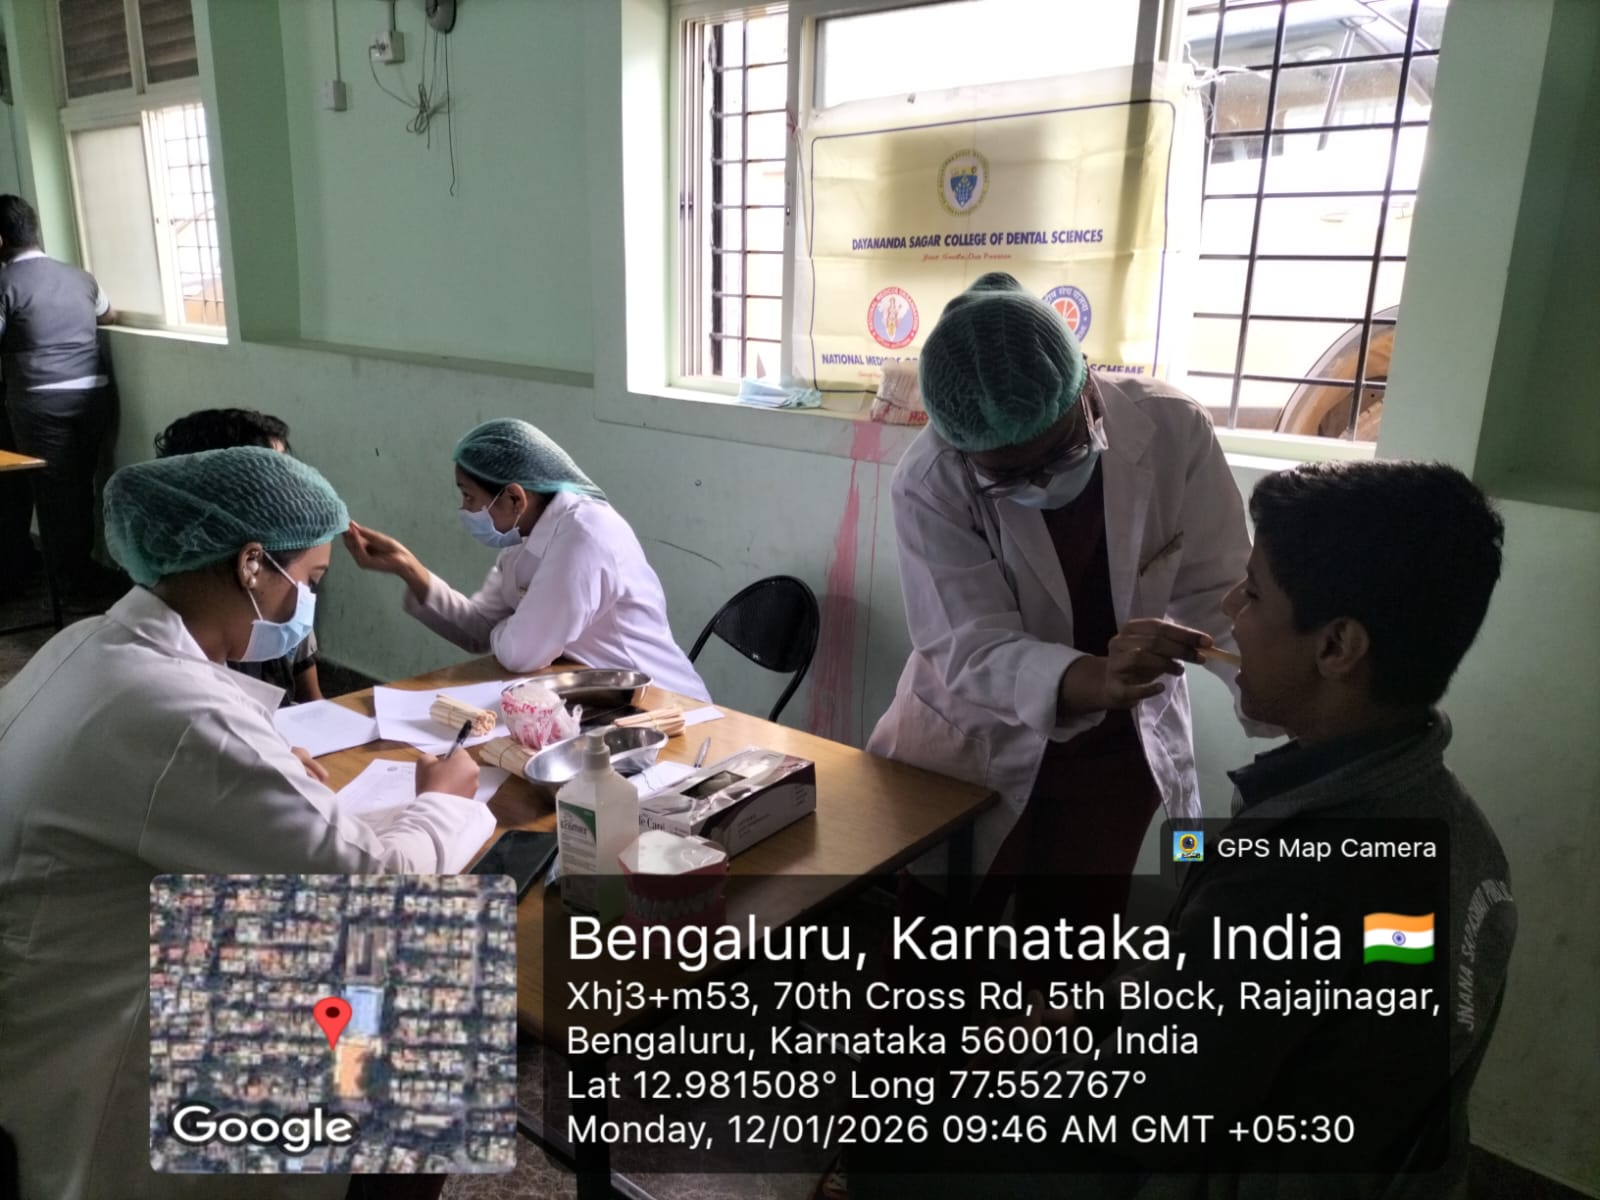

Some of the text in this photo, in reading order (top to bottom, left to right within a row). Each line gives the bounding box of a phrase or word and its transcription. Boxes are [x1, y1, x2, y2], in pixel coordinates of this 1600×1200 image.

[852, 229, 1103, 250] DAYANANDA SAGAR COLLEGE OF DENTAL SCIENCES
[821, 353, 864, 365] NATIONAL
[1458, 964, 1475, 1031] JNANA
